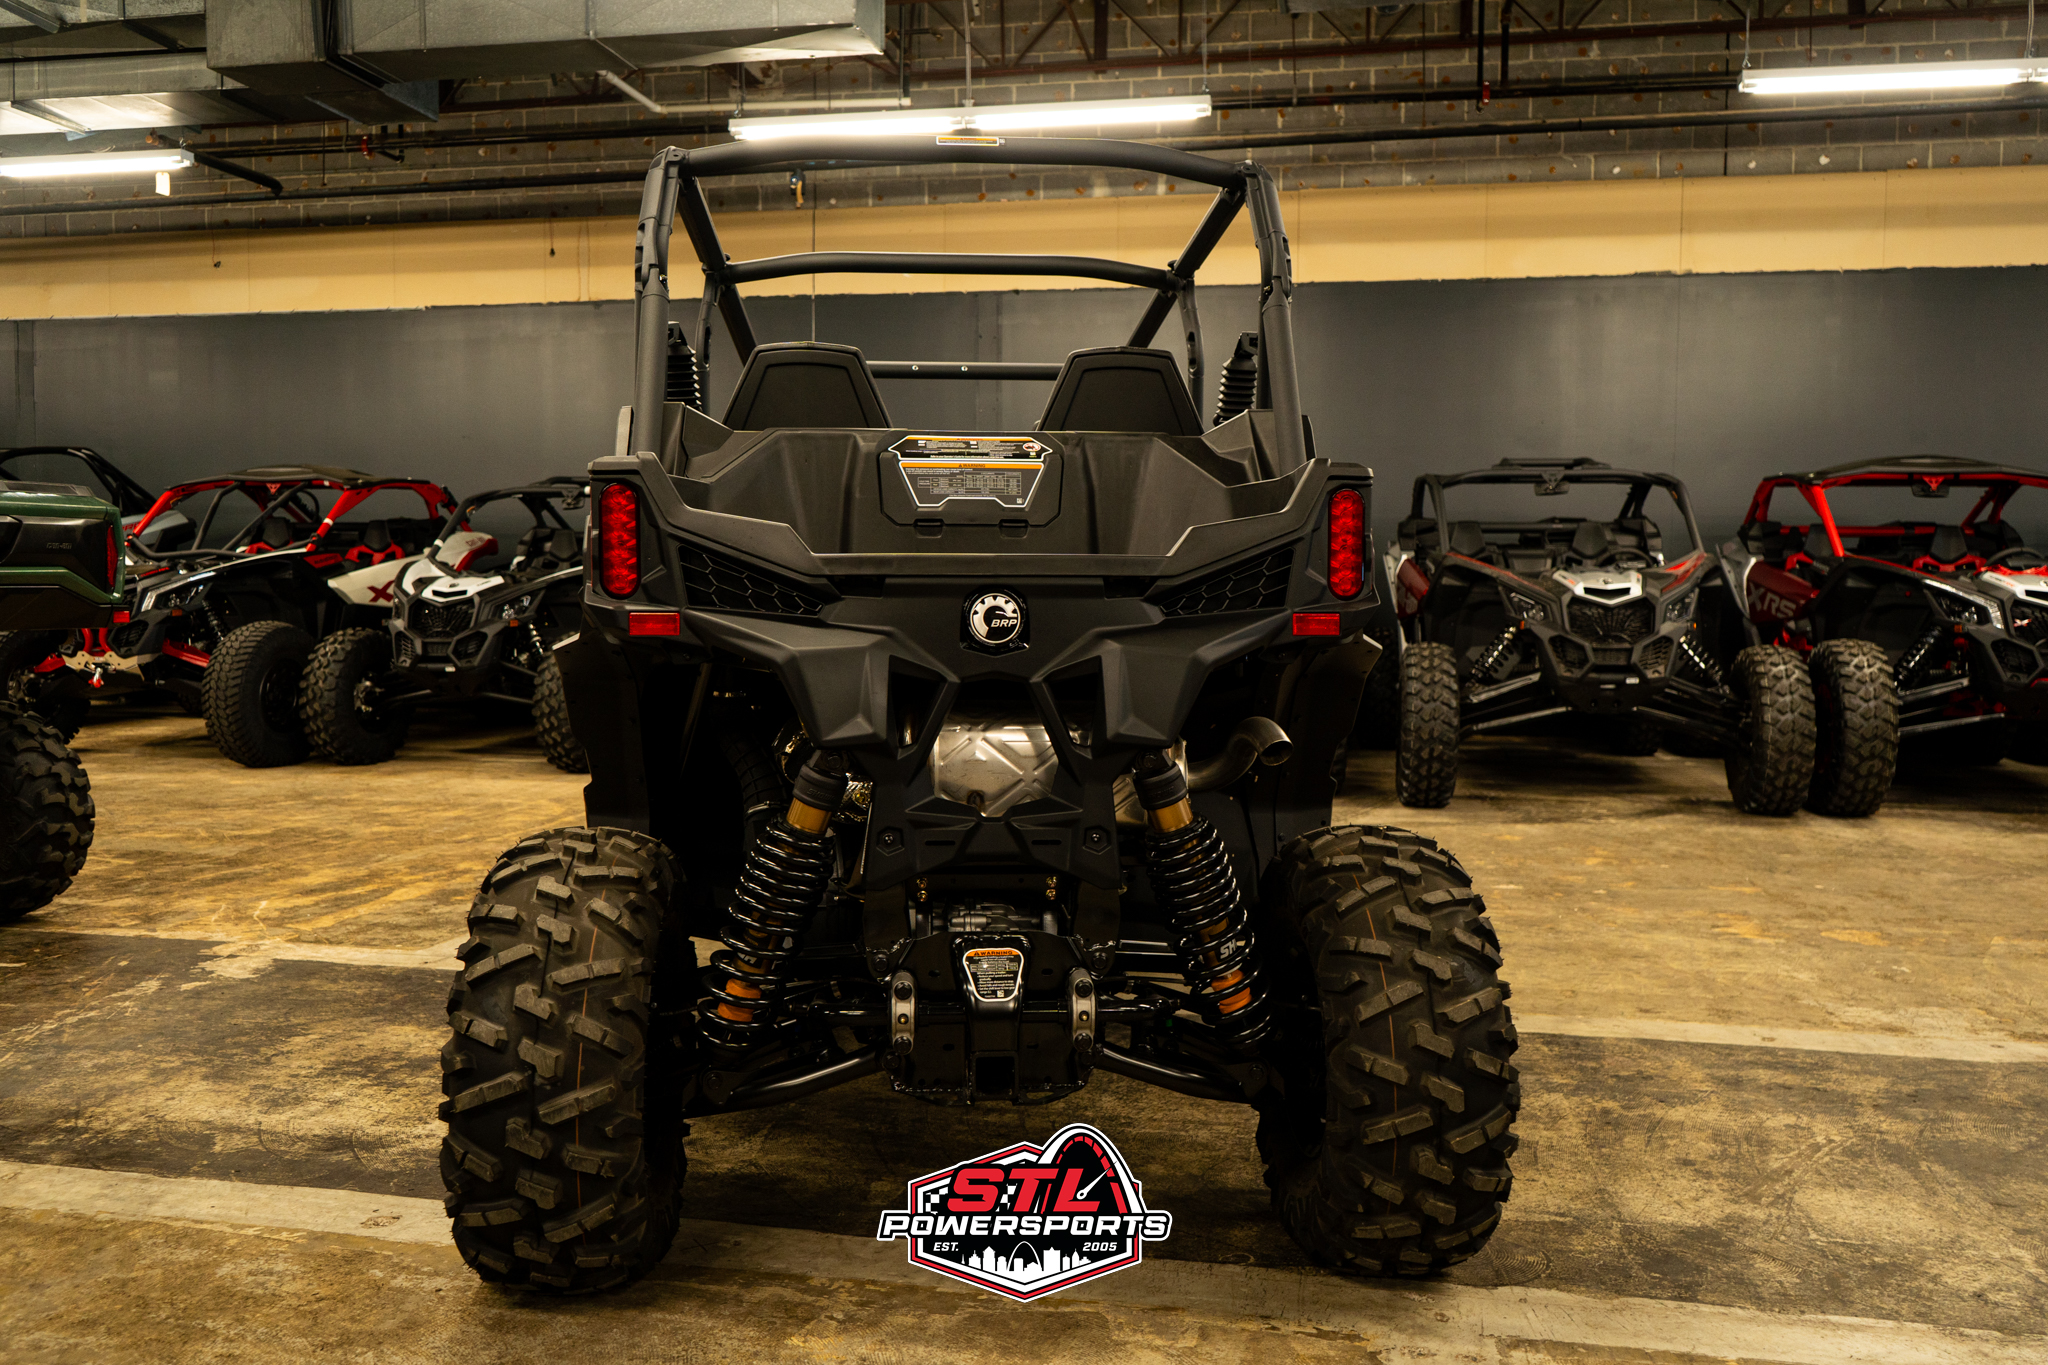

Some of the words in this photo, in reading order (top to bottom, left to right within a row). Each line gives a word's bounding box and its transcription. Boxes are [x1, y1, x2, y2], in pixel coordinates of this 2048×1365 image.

[1748, 582, 1797, 619] XRS
[990, 618, 1018, 628] BRP
[1219, 938, 1238, 960] SH
